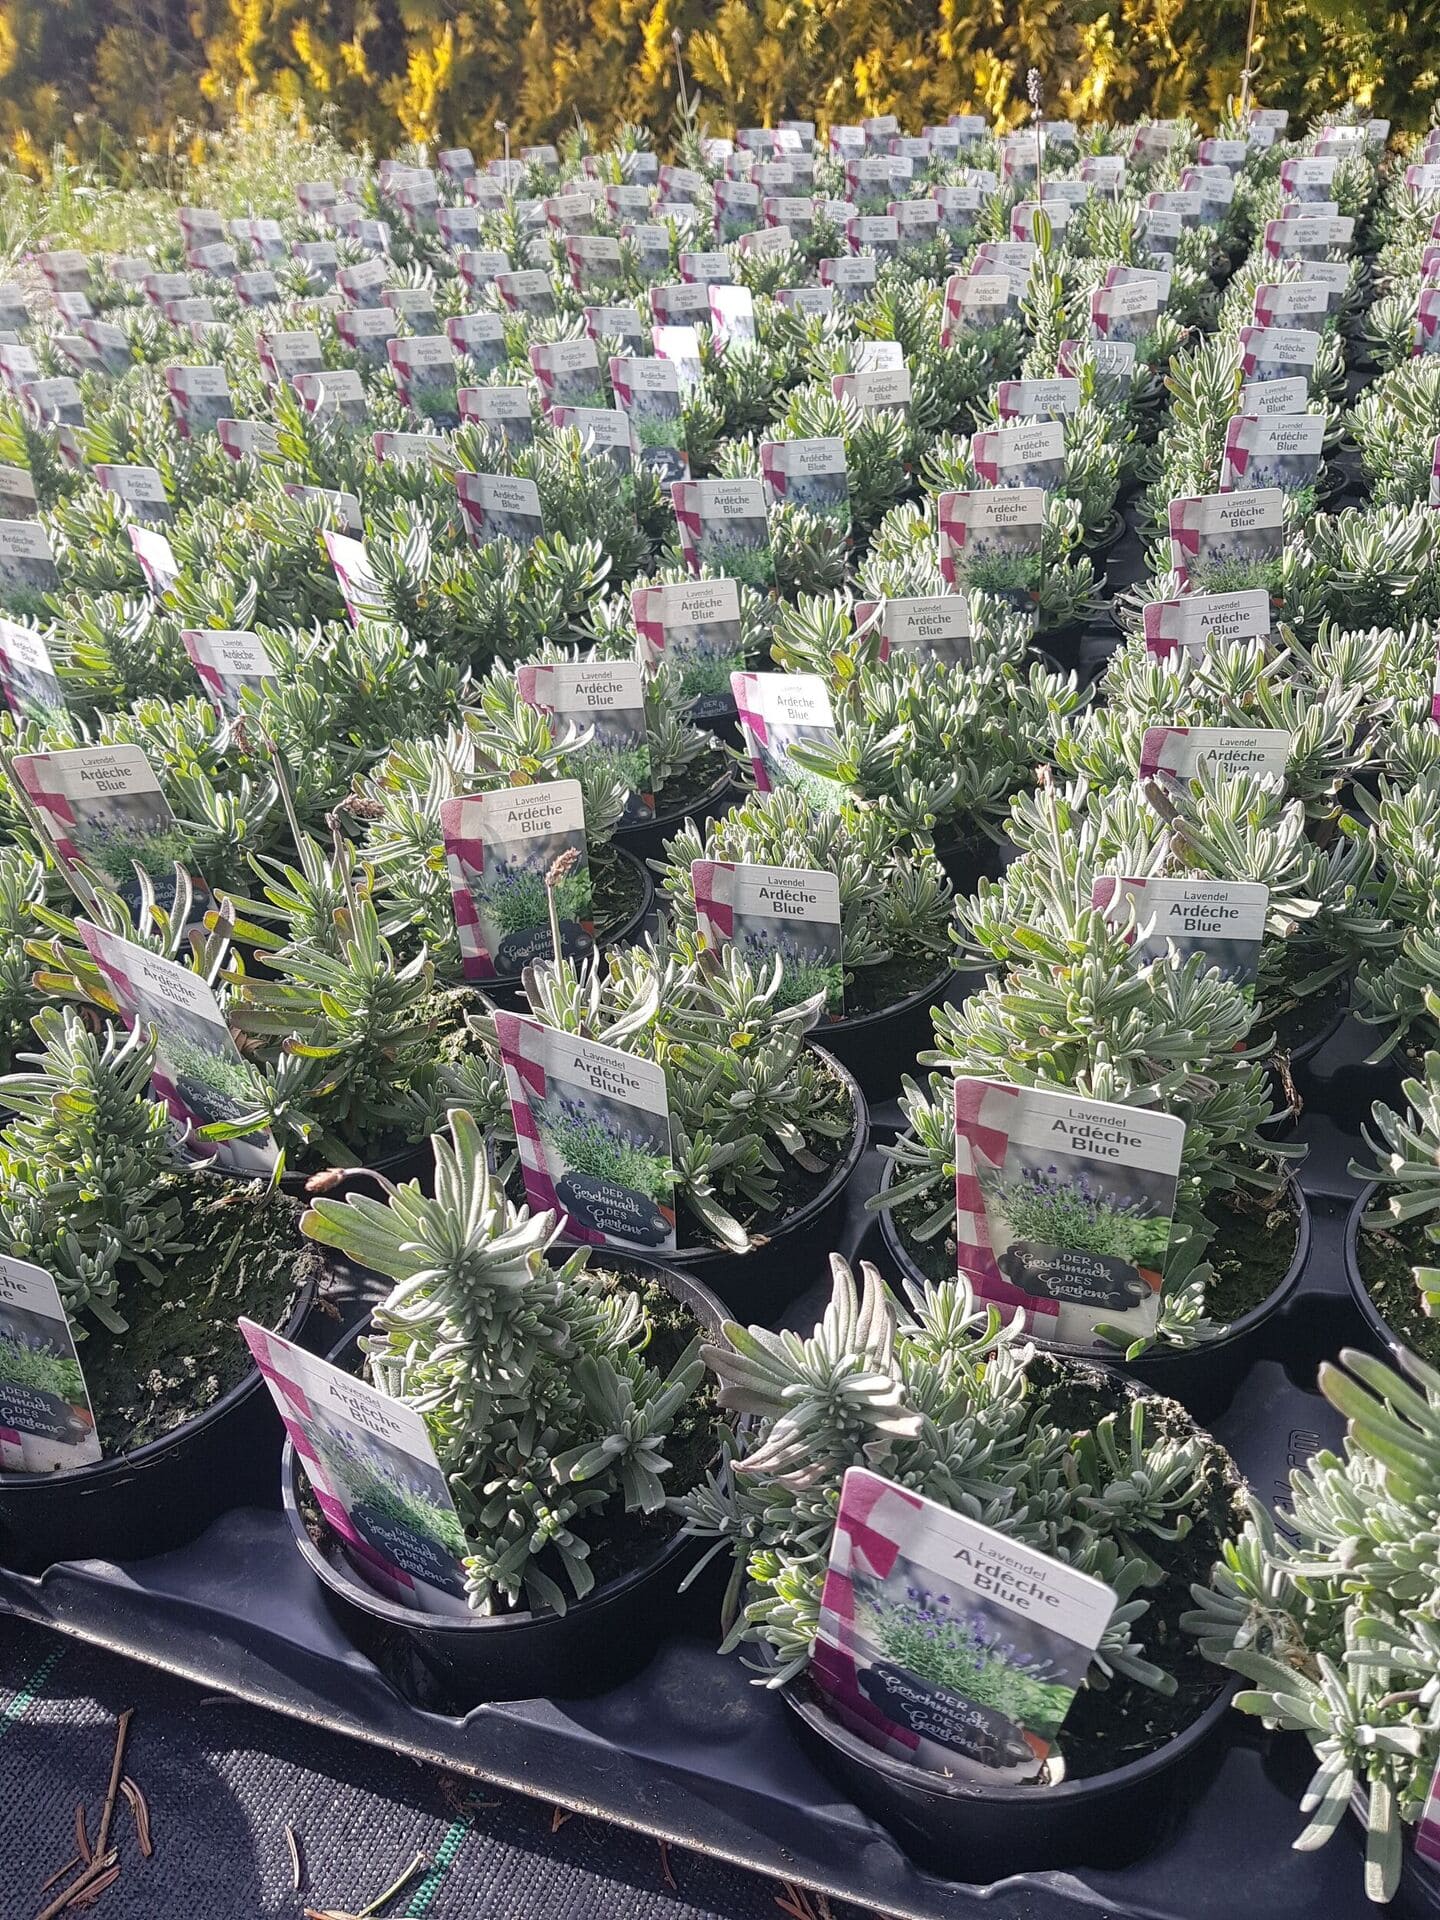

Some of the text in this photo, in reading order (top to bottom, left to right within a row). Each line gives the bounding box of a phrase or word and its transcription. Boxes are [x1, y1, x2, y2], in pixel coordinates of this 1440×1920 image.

[1267, 404, 1285, 413] Blue
[1277, 442, 1298, 450] Blue
[1022, 451, 1042, 459] Blue
[807, 462, 826, 471] Blue
[723, 506, 743, 514] Blue
[995, 514, 1018, 522] Blue
[1230, 517, 1255, 527] Blue
[1208, 601, 1240, 611] Lavendel
[691, 611, 714, 620] Blue
[908, 614, 951, 626] Ardéche
[1201, 612, 1250, 626] Ardéche
[918, 626, 943, 635] Blue
[1213, 624, 1240, 636] Blue
[575, 682, 623, 695] Ardéche
[587, 695, 614, 705] Blue
[788, 708, 809, 720] Blue
[1220, 738, 1257, 746] Lavendel
[81, 756, 116, 766] Lavendel
[1207, 750, 1265, 762] Ardéche
[80, 767, 132, 781] Ardéche
[96, 781, 126, 791] Blue
[515, 793, 550, 806] Lavendel
[507, 806, 562, 822] Ardéche
[521, 820, 551, 833] Blue
[768, 876, 805, 887] Lavendel
[759, 887, 817, 903] Ardéche
[1184, 891, 1228, 901] Lavendel
[773, 902, 804, 915] Blue
[1170, 904, 1239, 919] Ardéche
[1184, 919, 1221, 932] Blue
[160, 984, 192, 1007] Blue
[583, 1049, 625, 1069] Lavendel
[573, 1057, 640, 1089] Ardéche
[590, 1075, 626, 1097] Blue
[1069, 1108, 1126, 1128] Lavendel
[1052, 1119, 1142, 1148] Ardéche
[1071, 1137, 1119, 1157] Blue
[602, 1186, 624, 1199] DER
[606, 1207, 627, 1219] DES
[1063, 1254, 1091, 1265] DER
[1065, 1275, 1092, 1285] DES
[334, 1377, 381, 1409] Lavendel
[329, 1385, 401, 1433] Ardéche
[350, 1407, 390, 1437] Blue
[978, 1541, 1047, 1581] Lavendel
[953, 1549, 1060, 1607] Ardéche
[973, 1573, 1030, 1610] Blue
[935, 1690, 969, 1712] DER
[933, 1713, 963, 1733] DES
